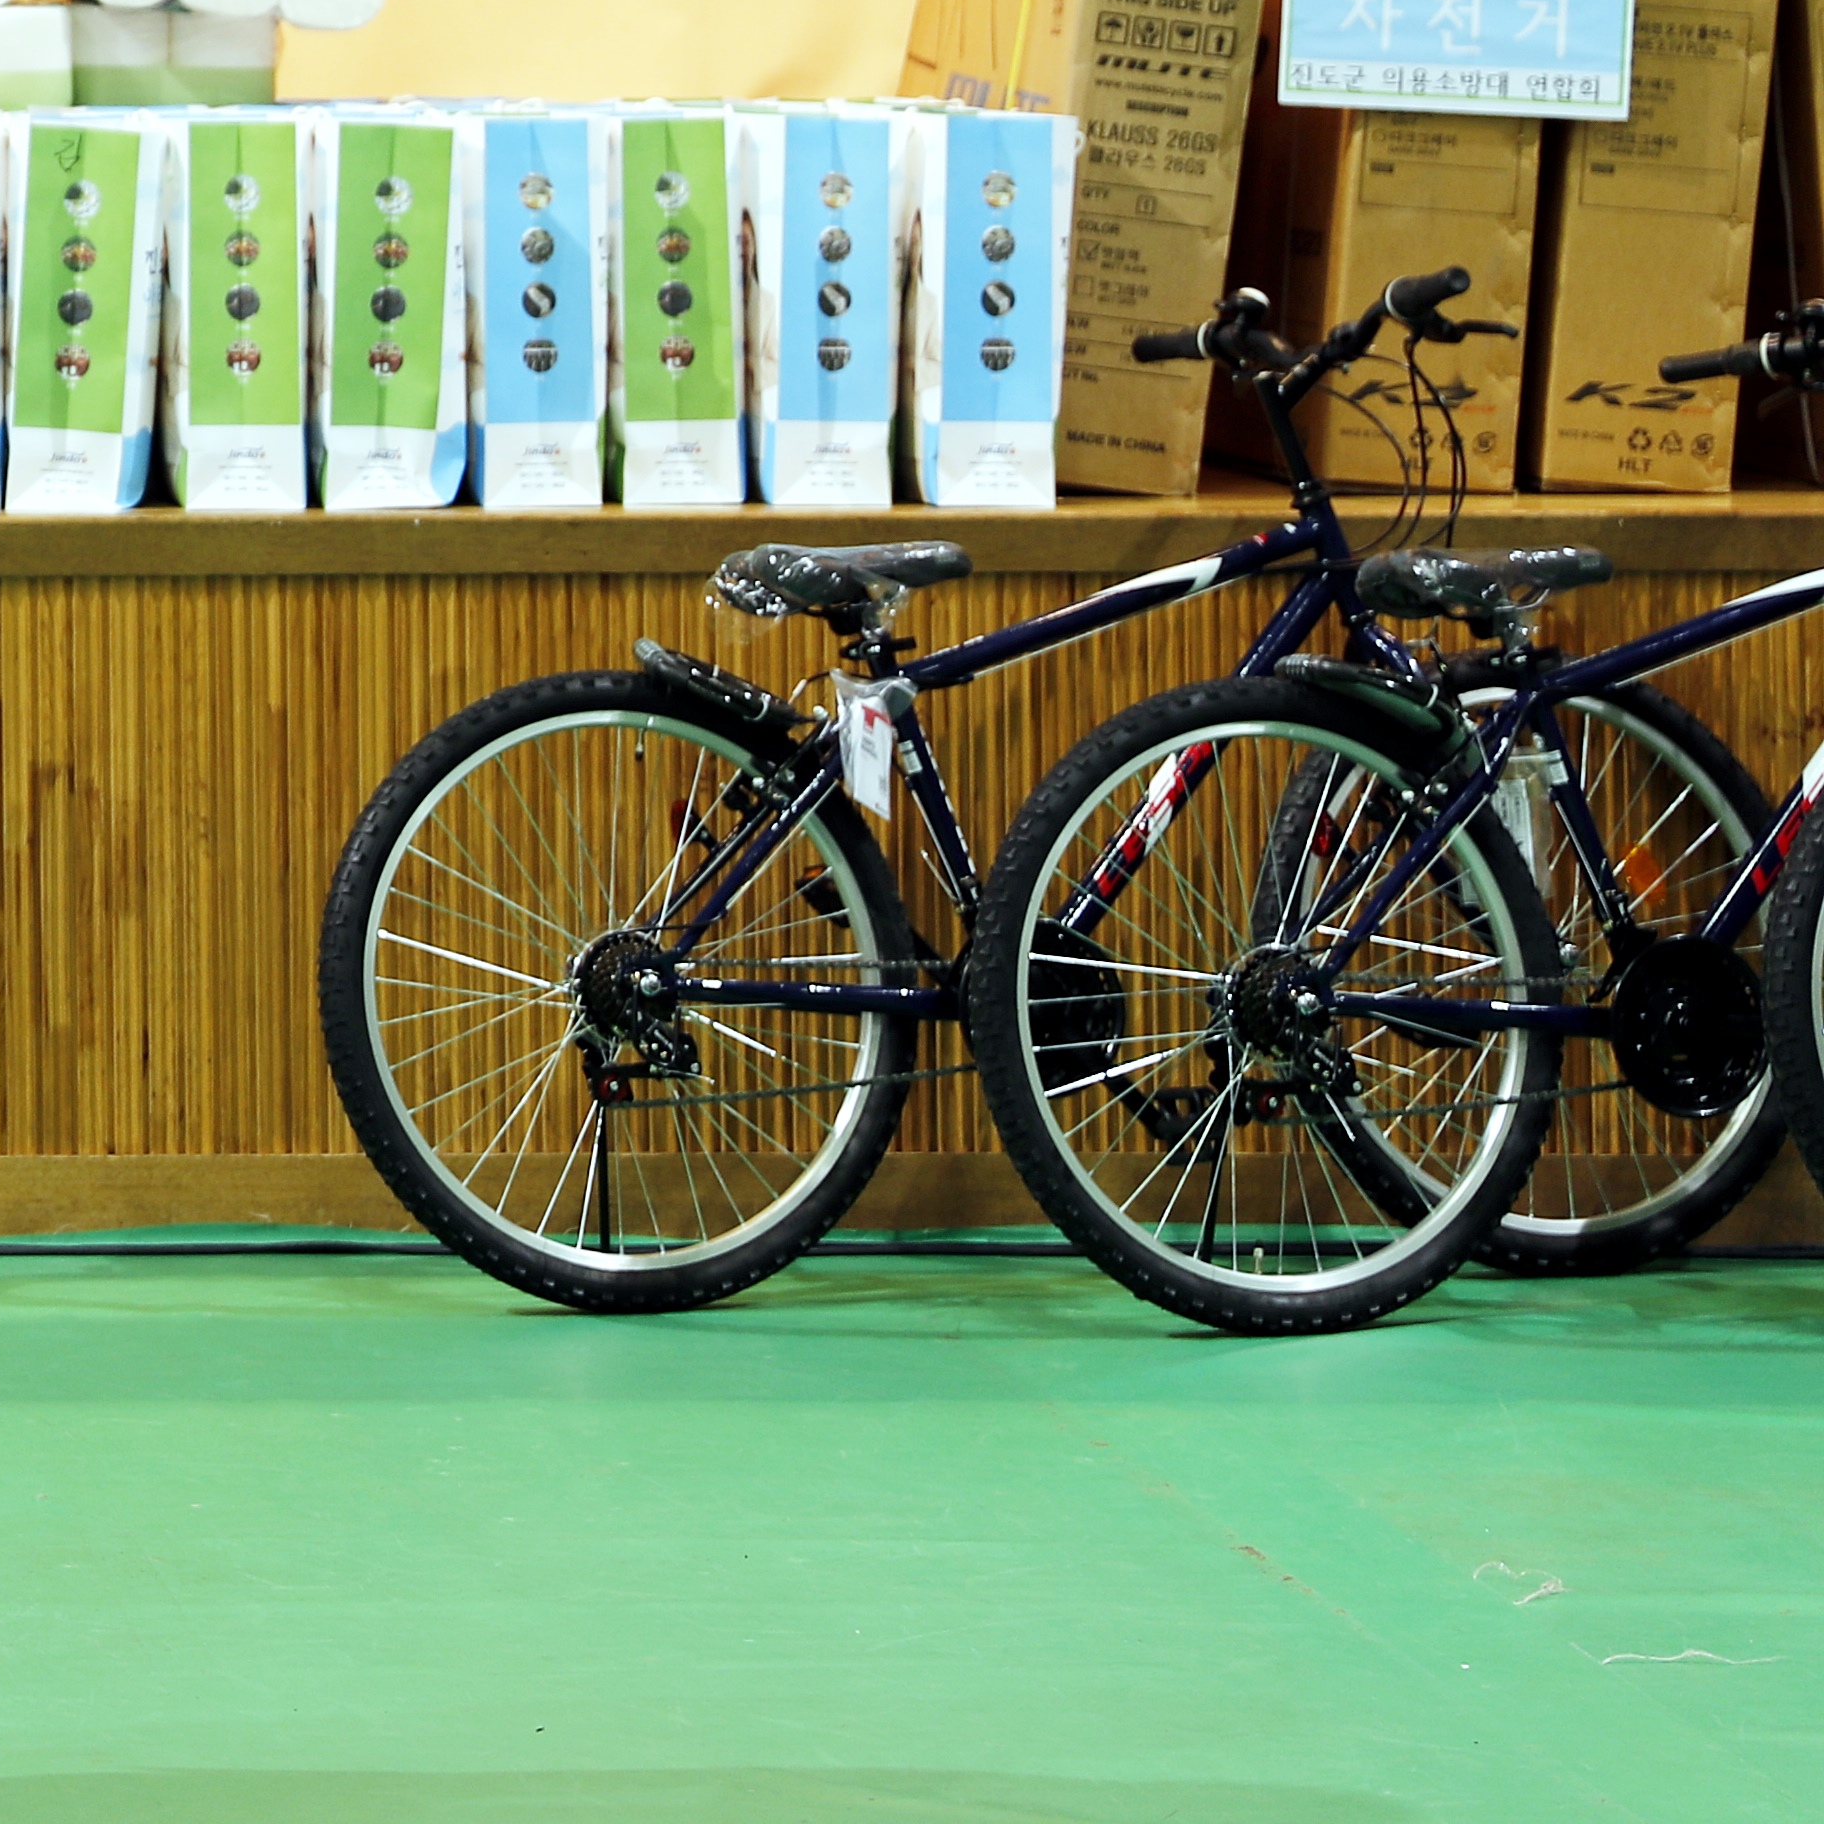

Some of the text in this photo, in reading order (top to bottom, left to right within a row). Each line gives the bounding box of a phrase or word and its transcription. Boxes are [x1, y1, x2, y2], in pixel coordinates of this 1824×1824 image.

[1290, 62, 1366, 93] 진도군
[1382, 67, 1509, 100] 의용소방대
[1526, 74, 1601, 104] 연합회
[1086, 119, 1157, 146] KLAUSS
[1567, 381, 1696, 410] K2
